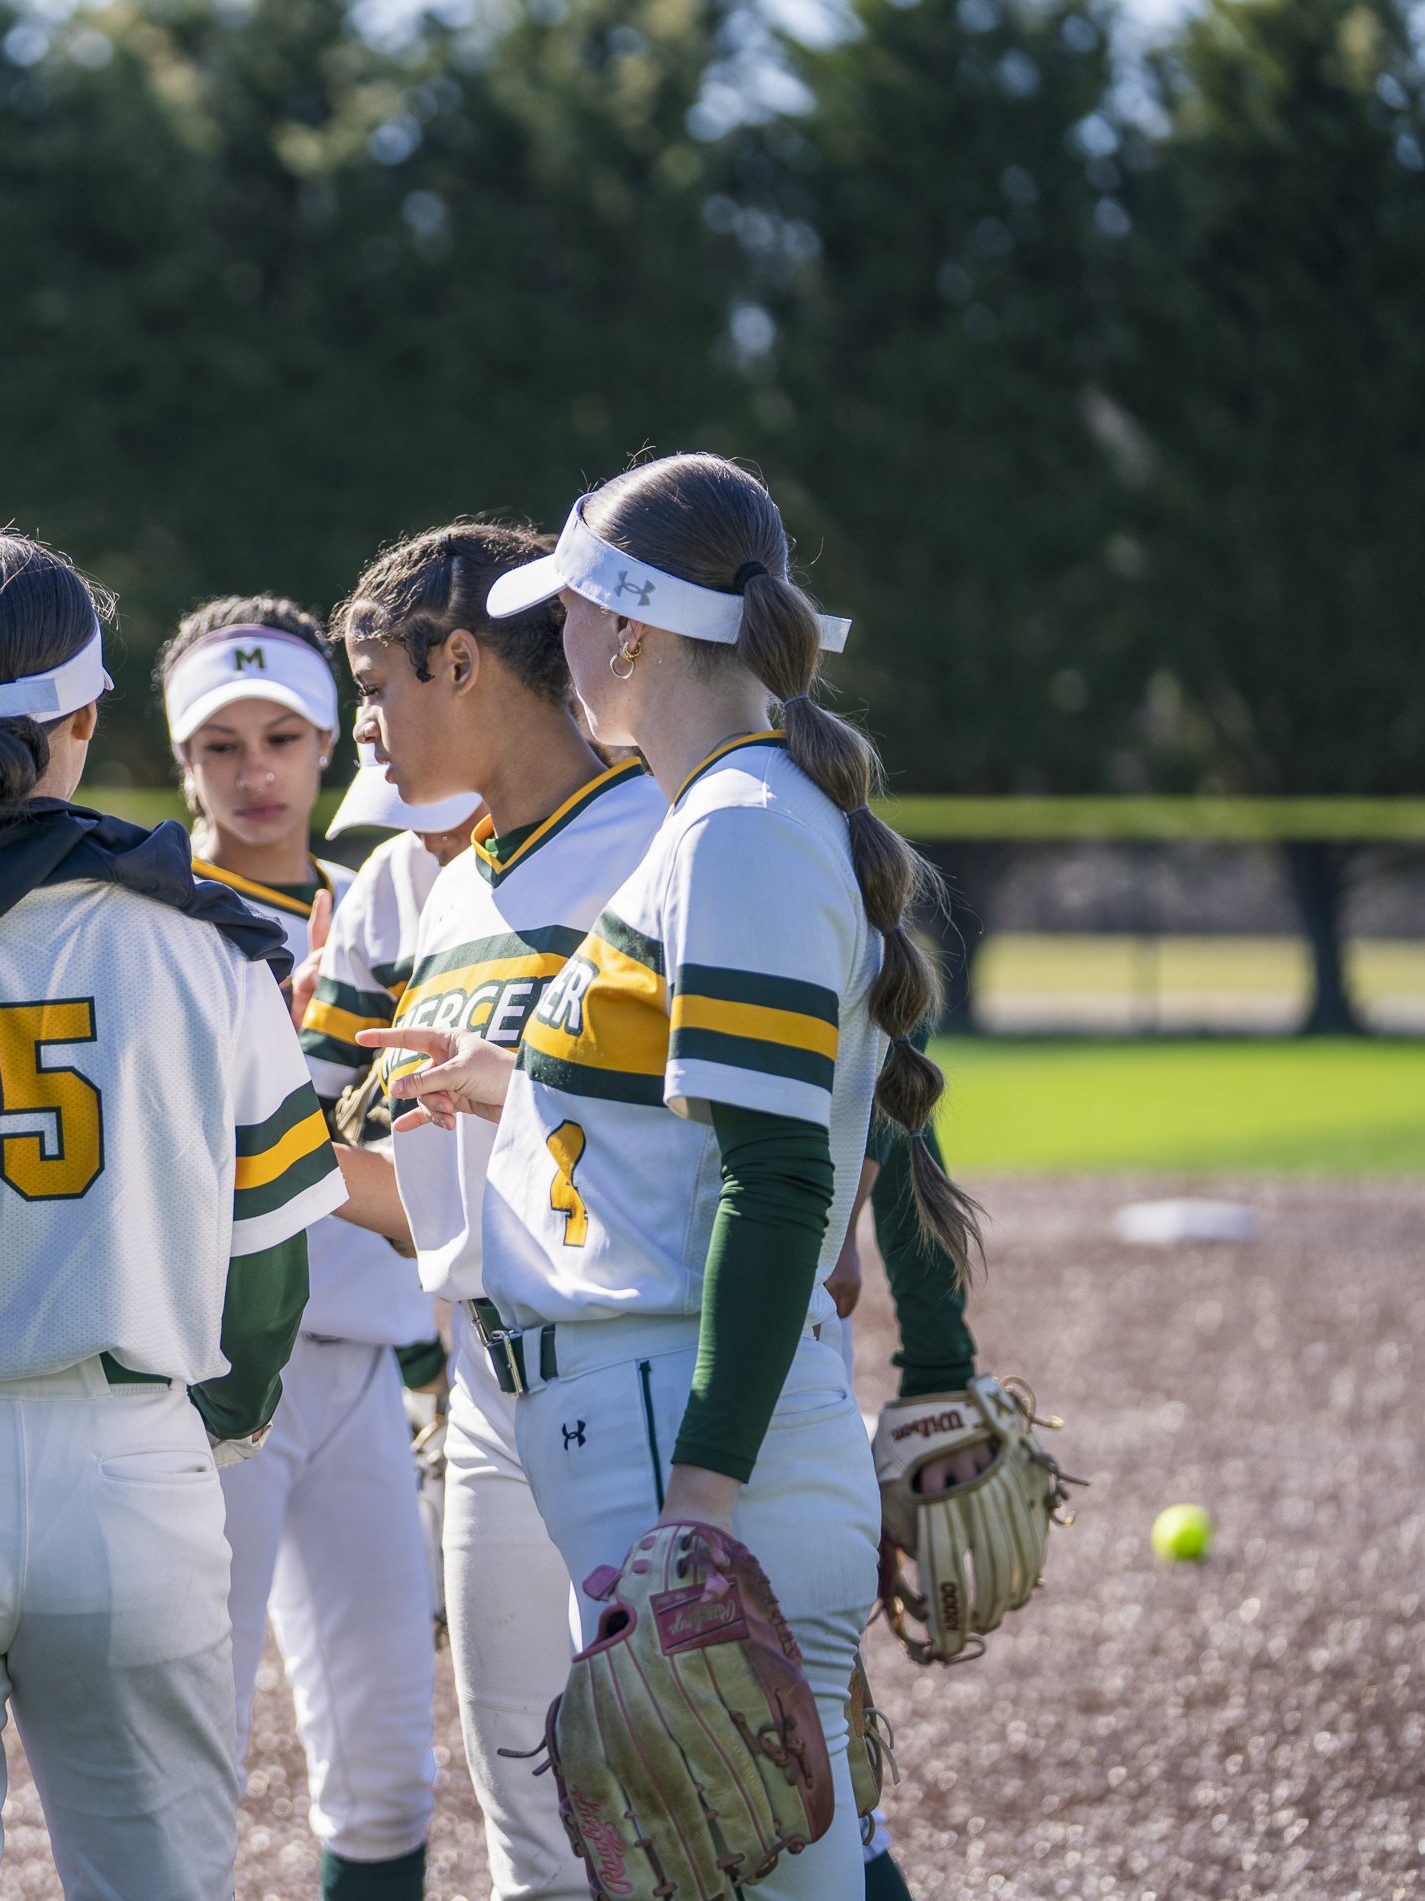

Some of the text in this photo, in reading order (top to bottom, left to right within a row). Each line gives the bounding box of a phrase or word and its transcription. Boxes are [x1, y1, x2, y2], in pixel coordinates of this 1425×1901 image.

[234, 647, 265, 671] M
[890, 1408, 964, 1441] Wilson
[667, 1599, 736, 1636] Rawlings
[570, 1783, 634, 1895] Rawlings
